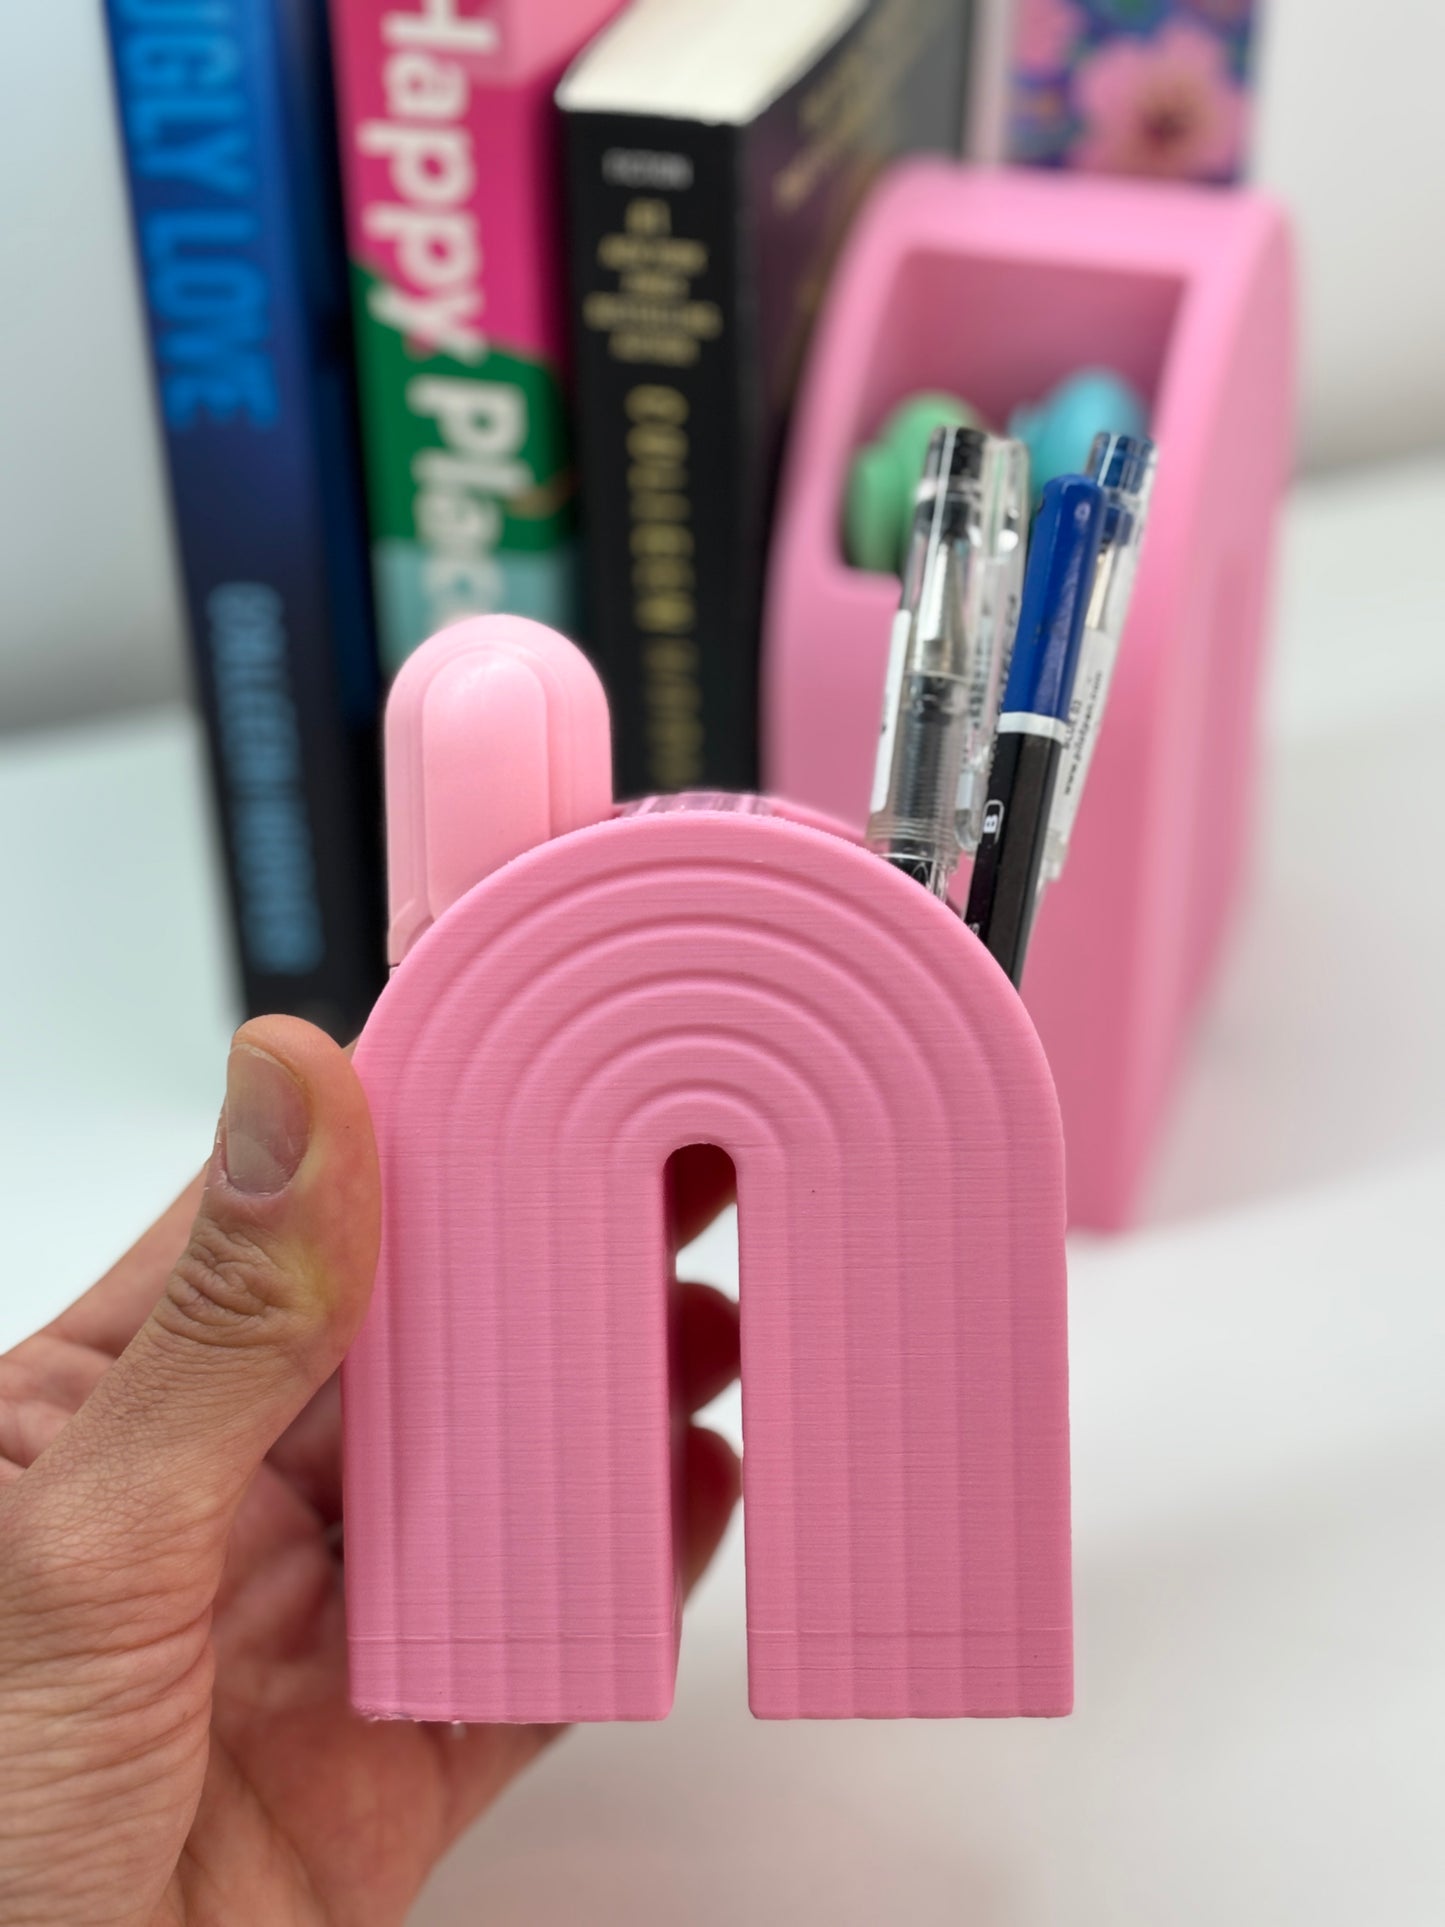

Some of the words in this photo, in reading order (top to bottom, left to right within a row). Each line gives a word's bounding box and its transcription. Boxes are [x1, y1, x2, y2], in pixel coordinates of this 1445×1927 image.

[358, 0, 497, 364] Happy
[146, 211, 277, 429] LOVE
[405, 375, 537, 622] Plac
[984, 815, 998, 834] B
